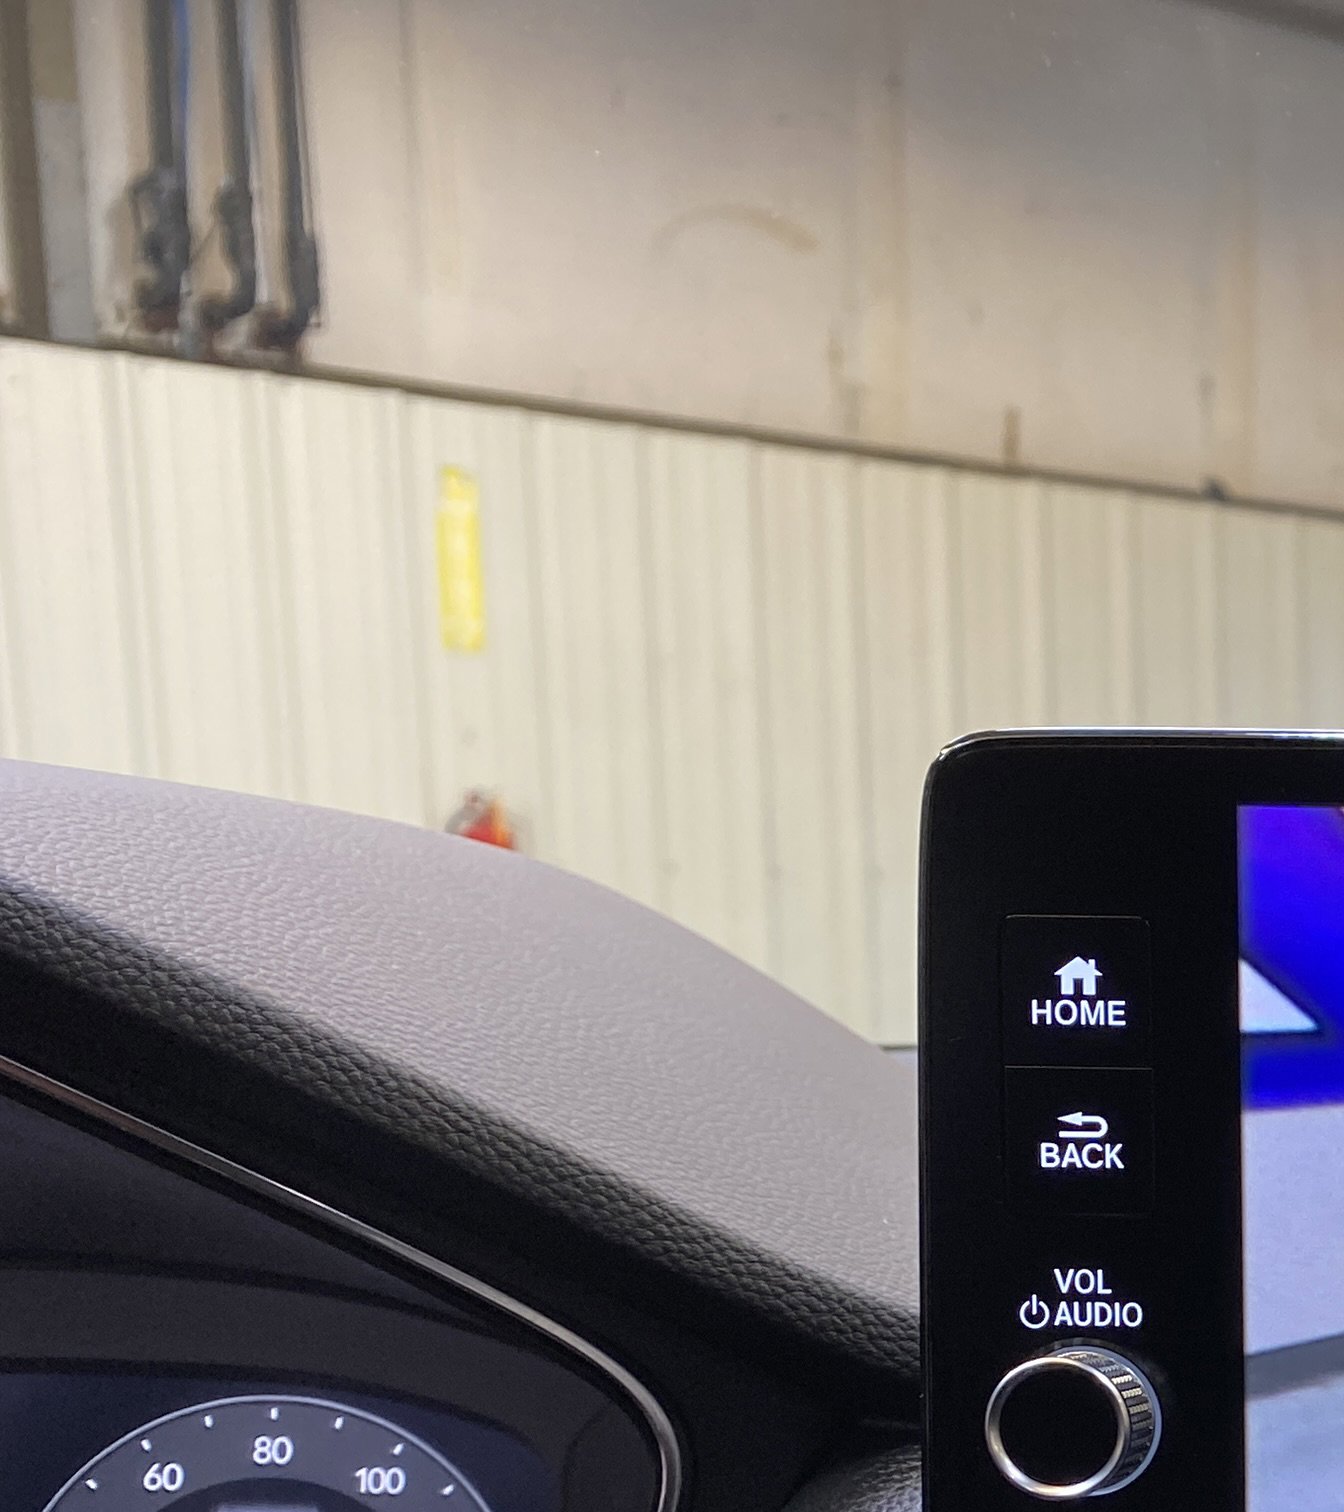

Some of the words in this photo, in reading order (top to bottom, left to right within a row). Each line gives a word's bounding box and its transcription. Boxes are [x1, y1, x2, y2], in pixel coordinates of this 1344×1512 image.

[1030, 999, 1128, 1027] HOME
[1039, 1142, 1126, 1170] BACK
[1053, 1268, 1113, 1296] VOL
[1053, 1301, 1144, 1329] AUDIO
[252, 1435, 294, 1465] 80
[142, 1462, 184, 1492] 60
[354, 1466, 406, 1495] 100
